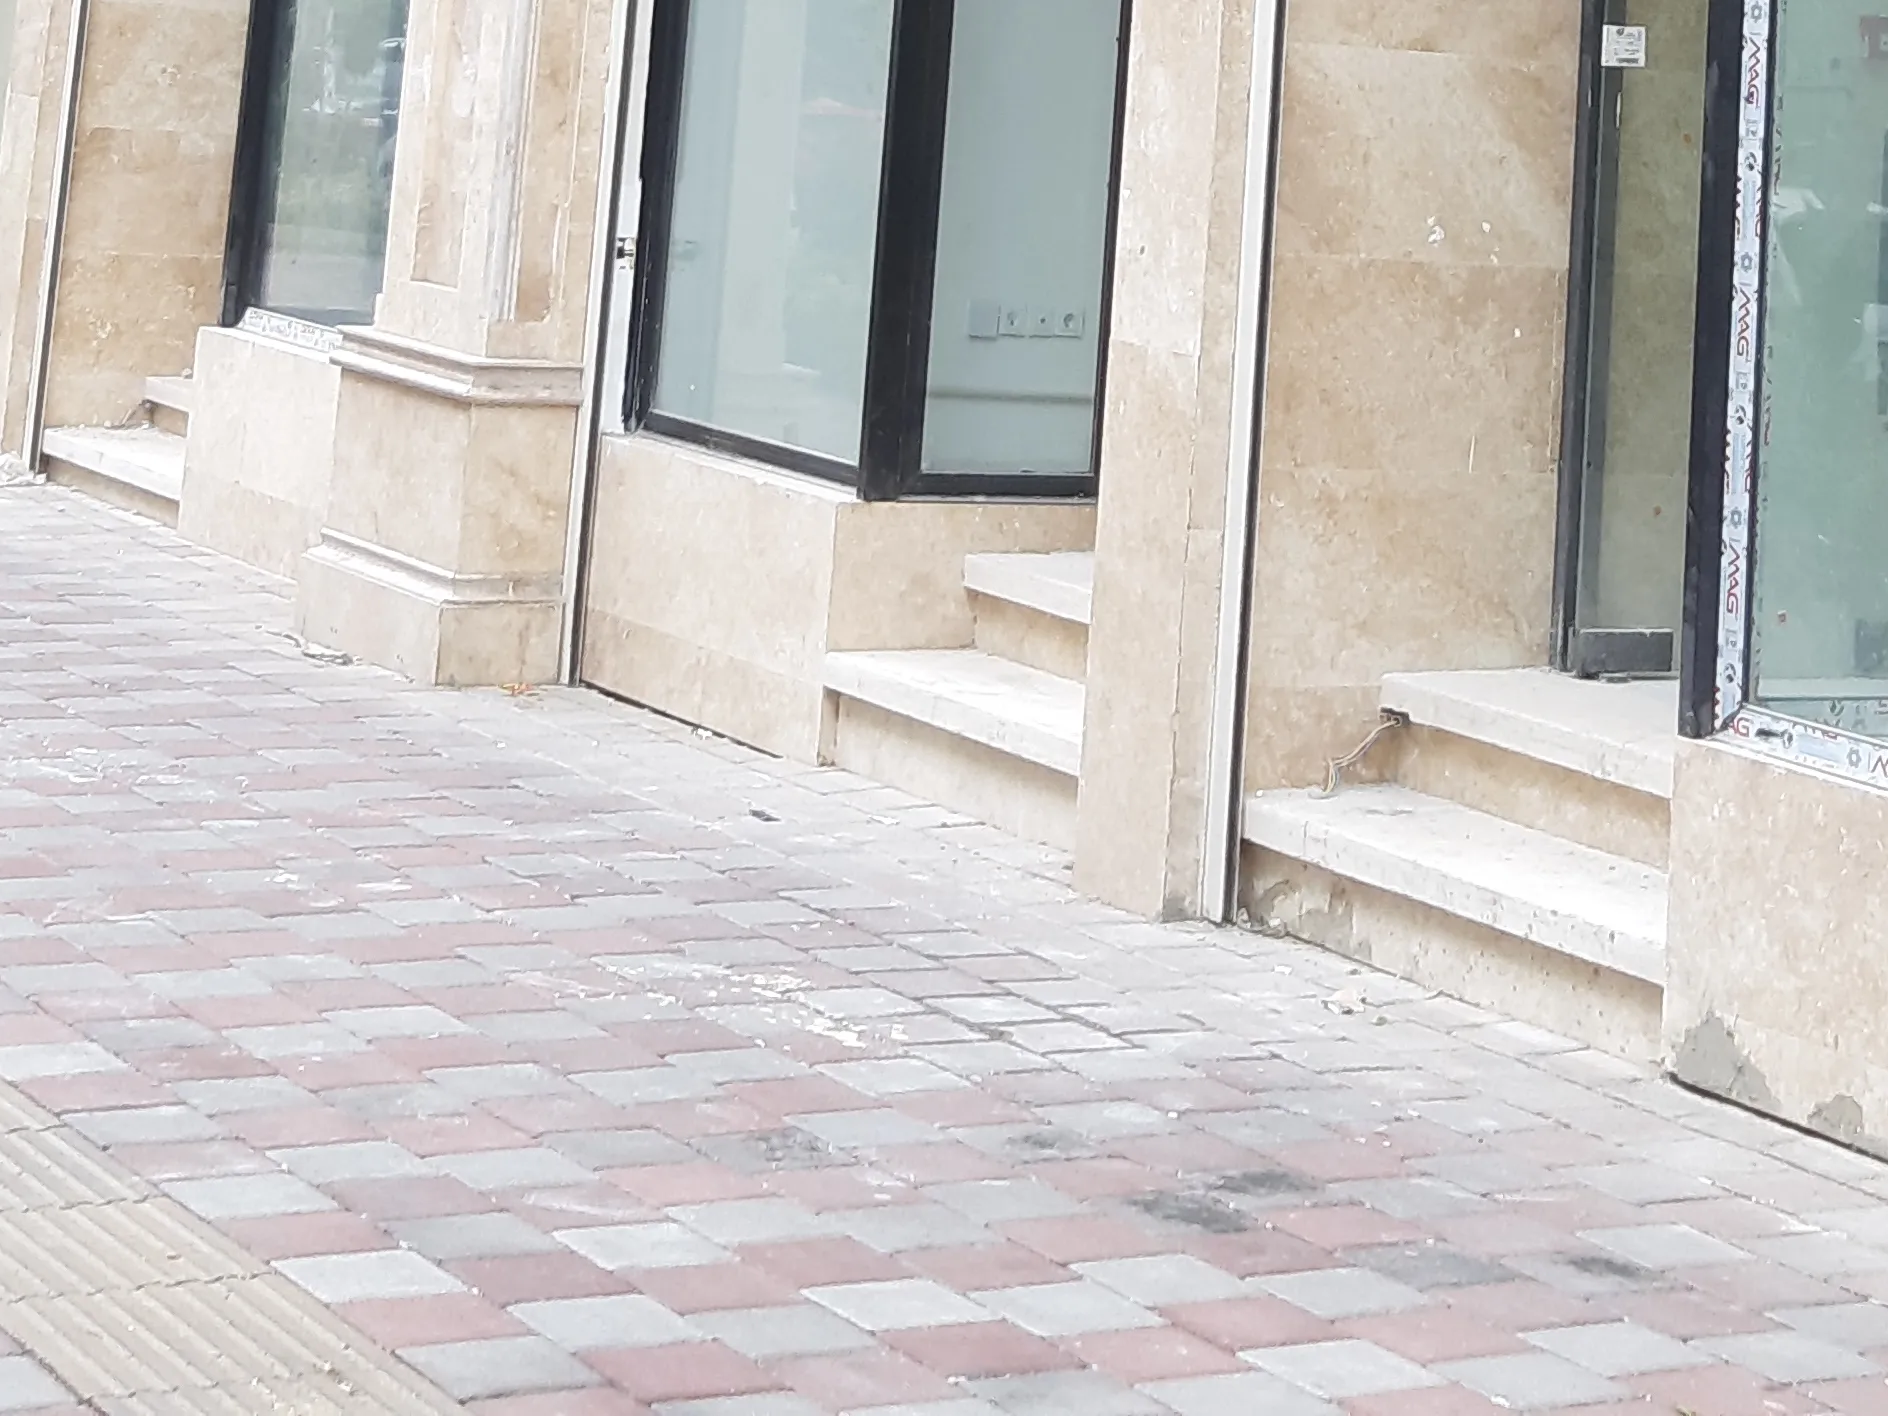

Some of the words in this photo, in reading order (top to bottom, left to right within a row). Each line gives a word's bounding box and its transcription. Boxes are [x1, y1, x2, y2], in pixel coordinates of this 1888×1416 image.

[1747, 39, 1761, 106] MAG
[1735, 288, 1752, 357] MAG
[1726, 544, 1741, 616] MAG
